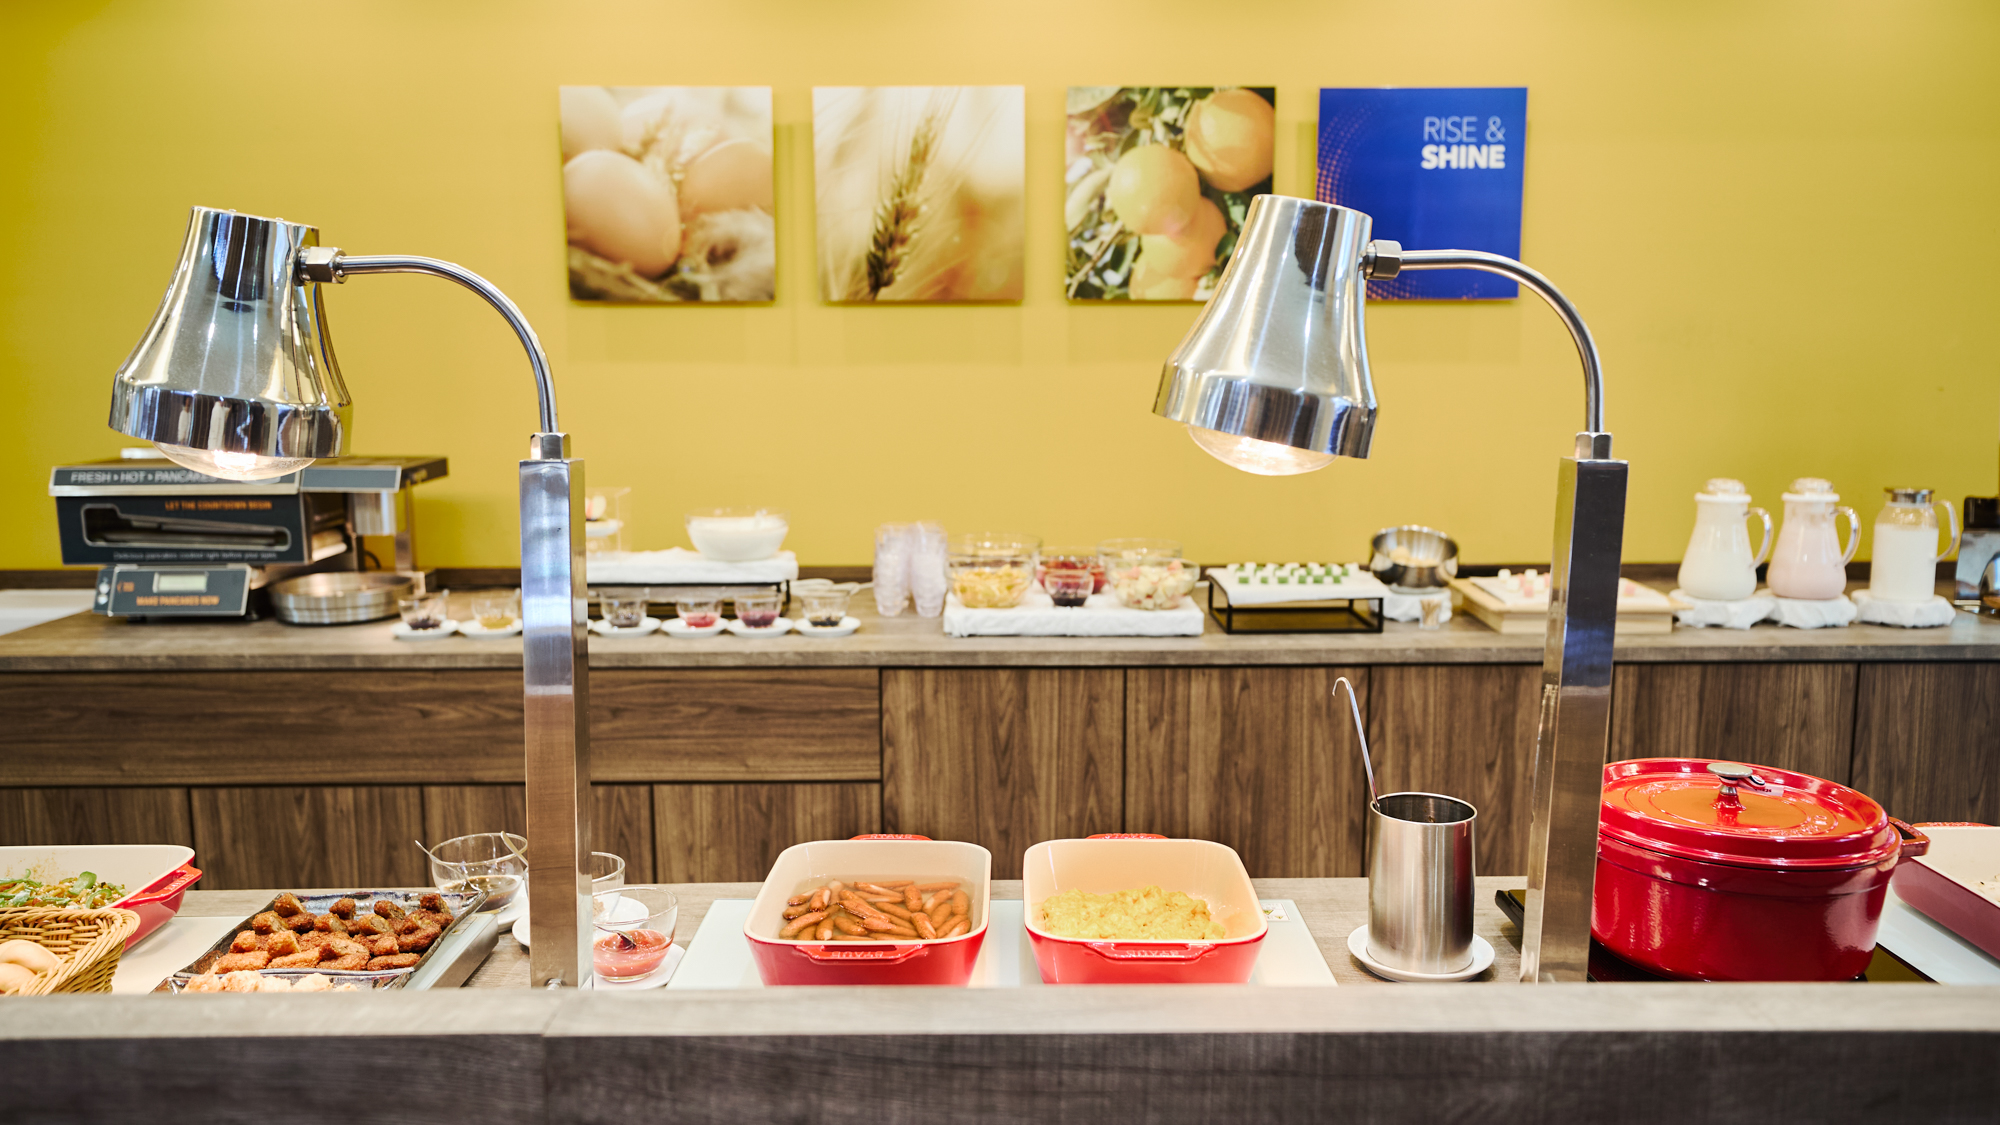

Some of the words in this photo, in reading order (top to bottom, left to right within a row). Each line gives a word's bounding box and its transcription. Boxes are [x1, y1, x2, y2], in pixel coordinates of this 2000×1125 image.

[1423, 116, 1478, 143] RISE
[1485, 115, 1506, 143] &
[1421, 144, 1506, 170] SHINE
[70, 471, 112, 484] FRESH
[120, 470, 147, 484] HOT
